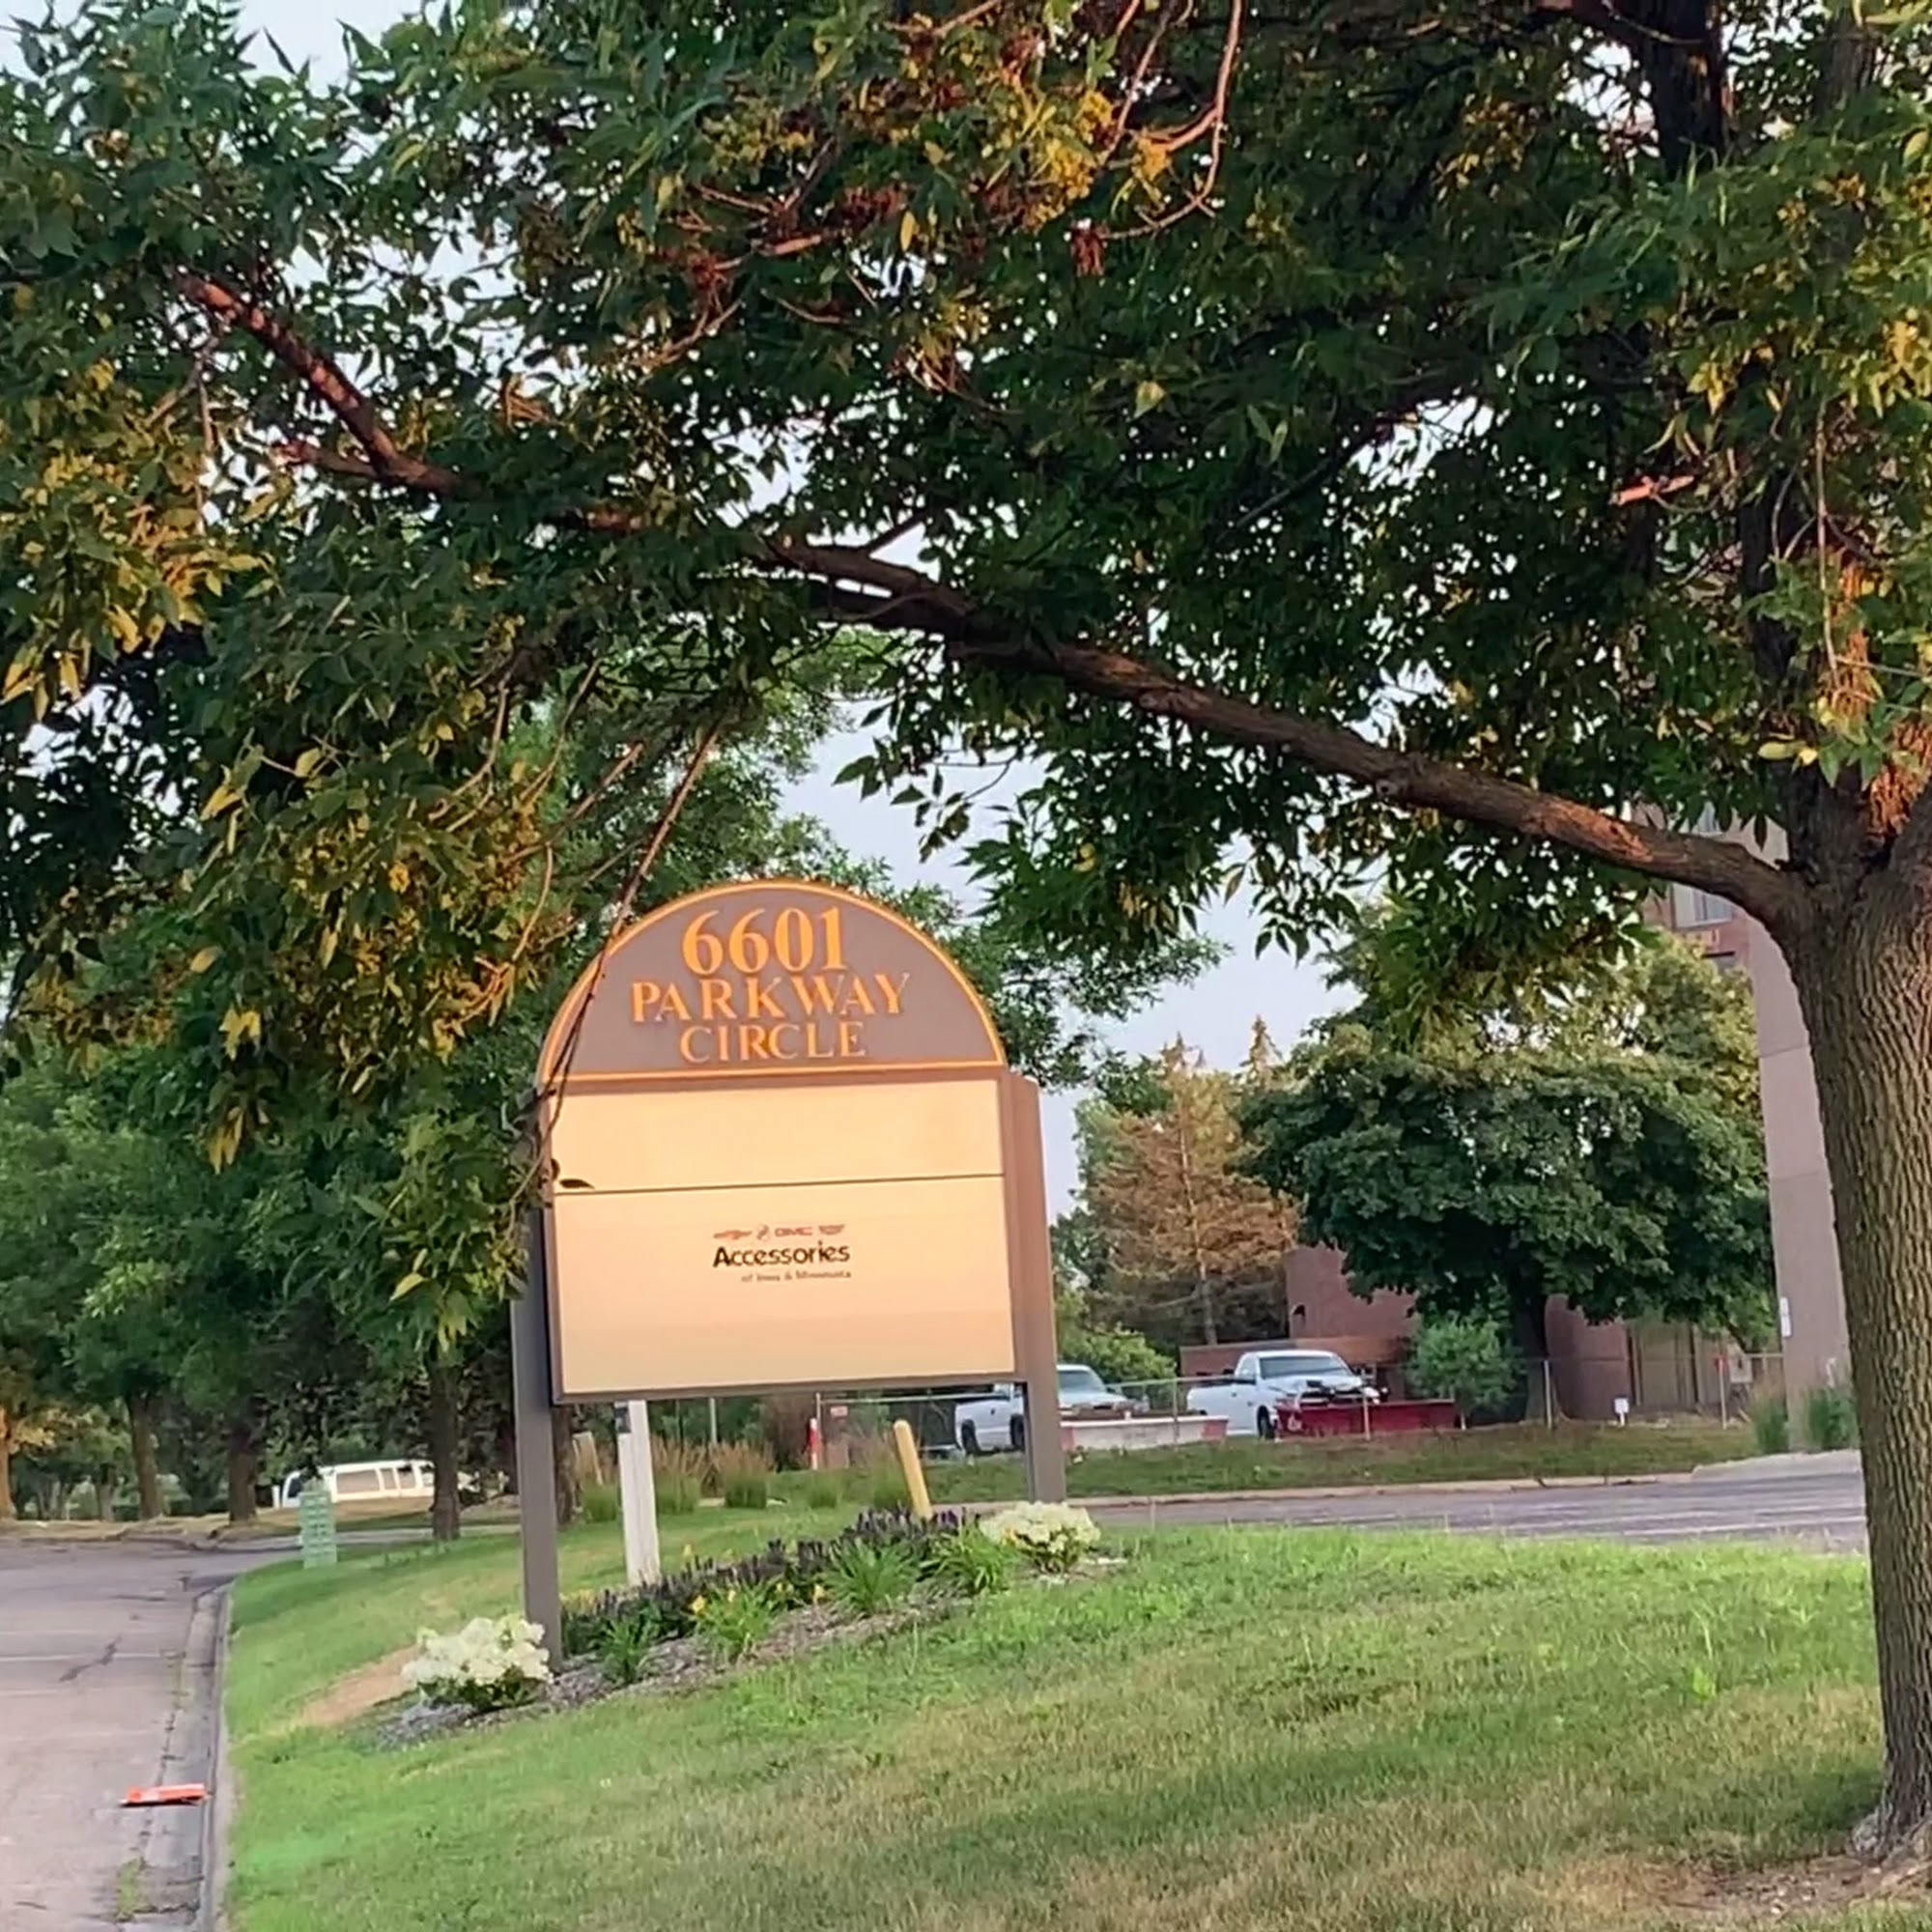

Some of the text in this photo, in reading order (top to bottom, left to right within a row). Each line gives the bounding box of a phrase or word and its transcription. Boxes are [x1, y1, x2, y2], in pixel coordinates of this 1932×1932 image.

[681, 906, 847, 976] 6601
[631, 972, 910, 1023] PARKWAY
[679, 1021, 867, 1063] CIRCLE
[712, 1239, 851, 1268] Accessories
